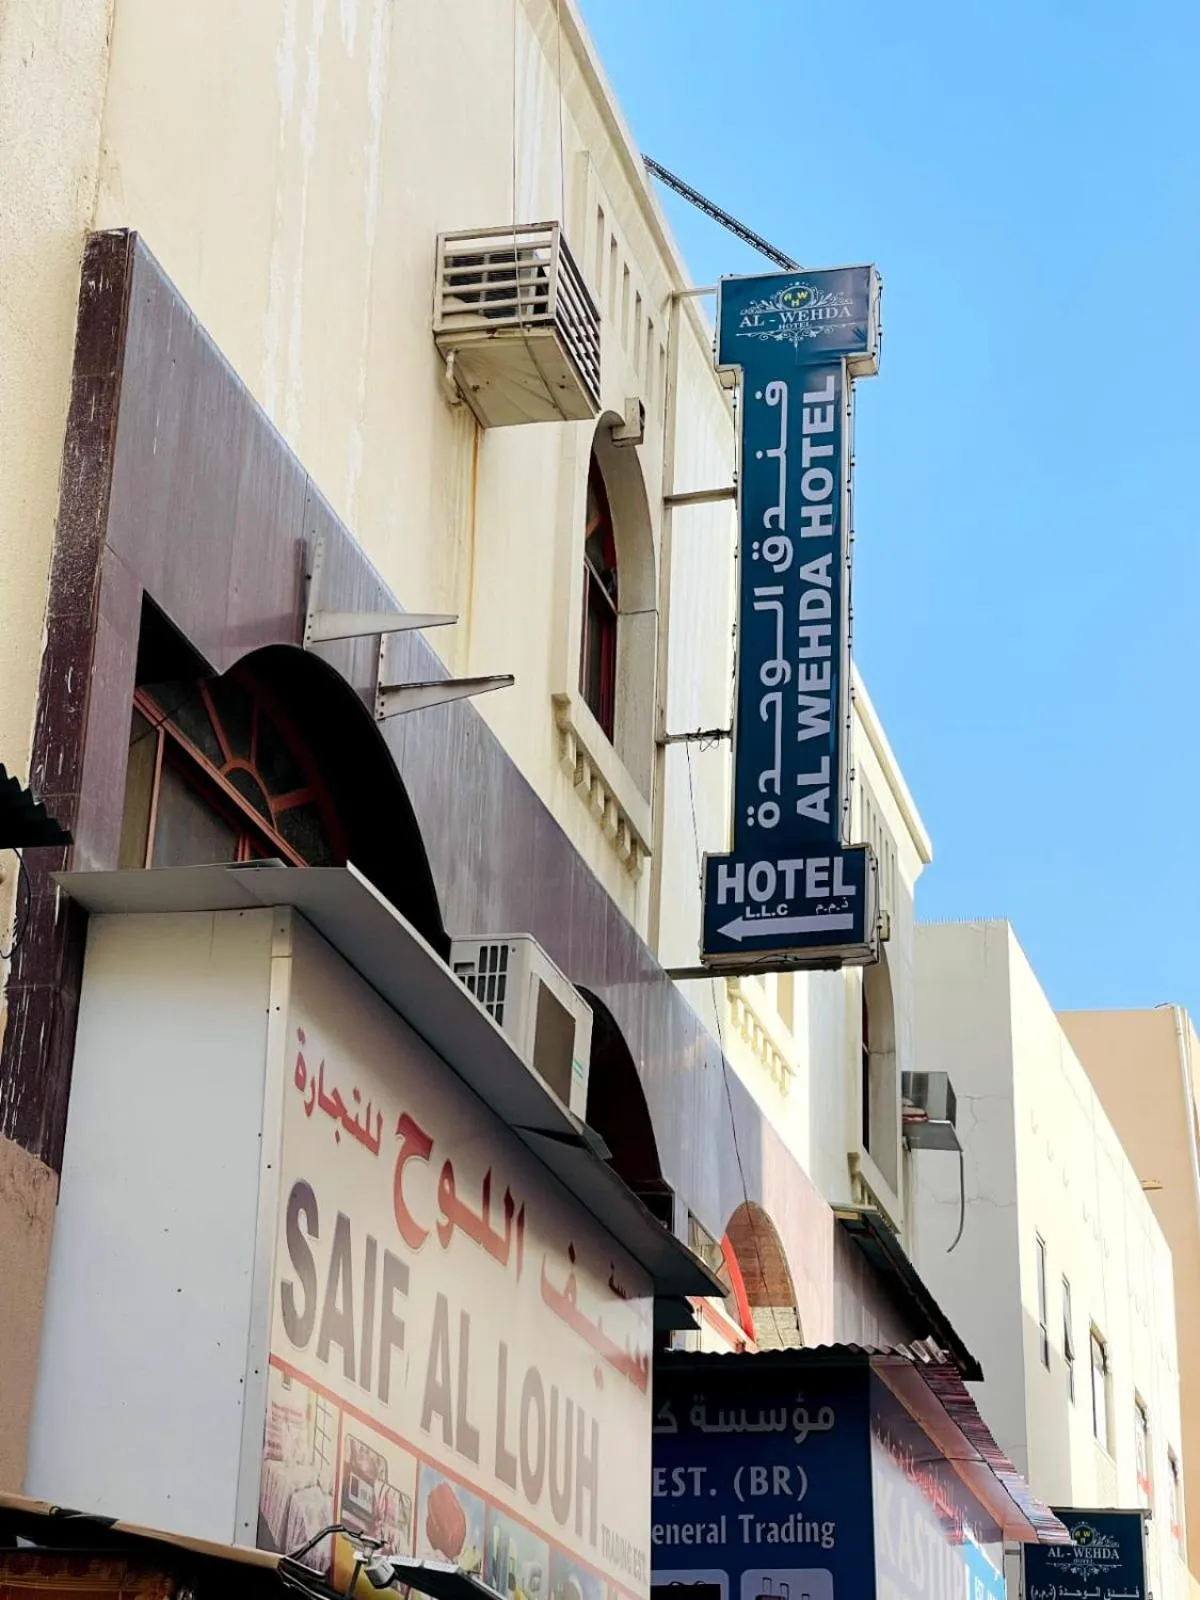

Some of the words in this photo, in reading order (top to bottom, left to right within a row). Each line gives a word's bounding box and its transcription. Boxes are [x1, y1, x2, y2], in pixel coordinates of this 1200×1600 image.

[739, 314, 765, 328] AL
[780, 306, 853, 324] WEHDA
[752, 380, 794, 574] فندق
[800, 375, 836, 538] HOTEL
[797, 552, 833, 742] WEHDA
[747, 585, 792, 829] الوحدة
[796, 755, 830, 824] AL
[717, 856, 857, 905] HOTEL
[745, 903, 789, 918] L.L.C
[393, 1111, 527, 1285] اللوح
[280, 1177, 411, 1405] SAIF
[420, 1291, 480, 1465] AL
[495, 1340, 599, 1548] LOUH
[690, 1391, 836, 1444] مؤسسة
[652, 1466, 718, 1497] EST.
[733, 1465, 809, 1502] (BR)
[652, 1514, 727, 1544] eneral
[738, 1512, 836, 1549] Trading
[1047, 1546, 1065, 1558] AL
[1072, 1546, 1120, 1560] WEHDA
